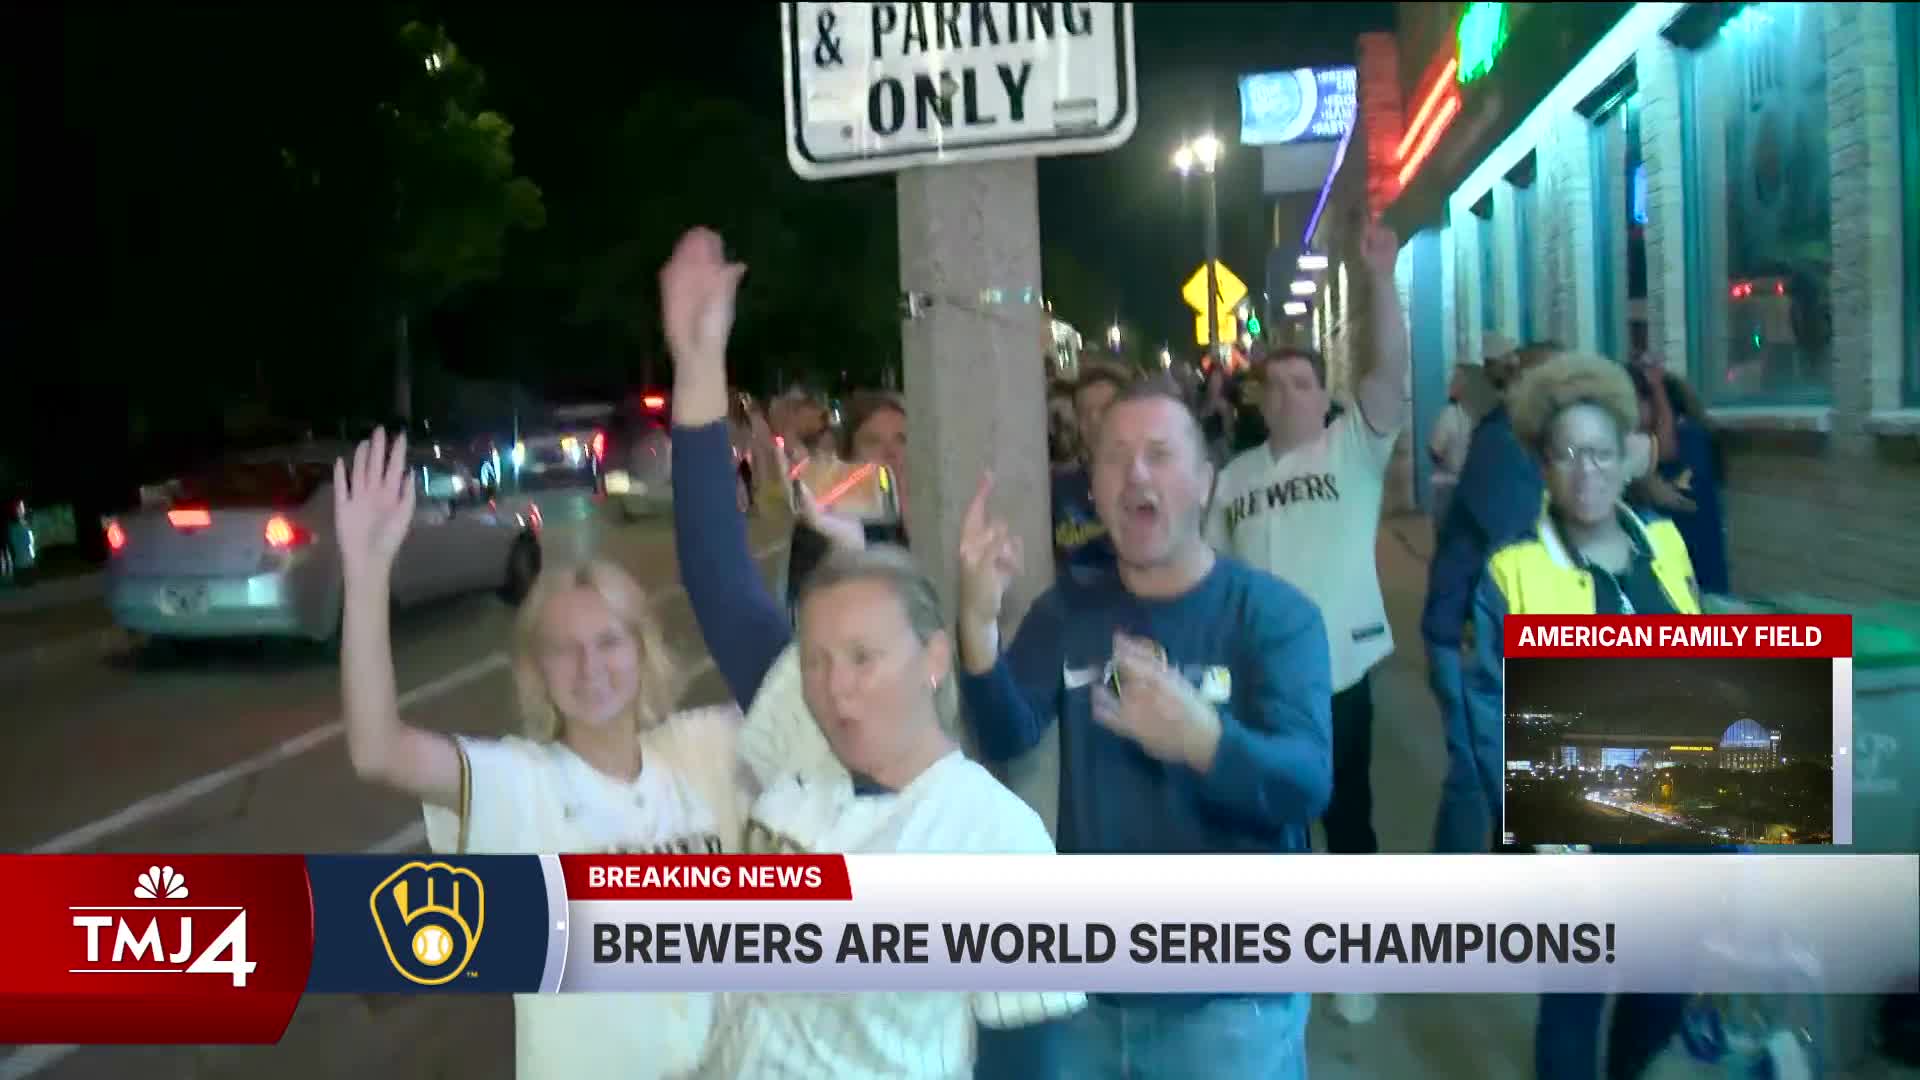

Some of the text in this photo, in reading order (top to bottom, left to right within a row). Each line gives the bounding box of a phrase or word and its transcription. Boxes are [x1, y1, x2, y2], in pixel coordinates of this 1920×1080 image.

[814, 3, 1092, 68] & PARKING
[868, 62, 1032, 136] ONLY
